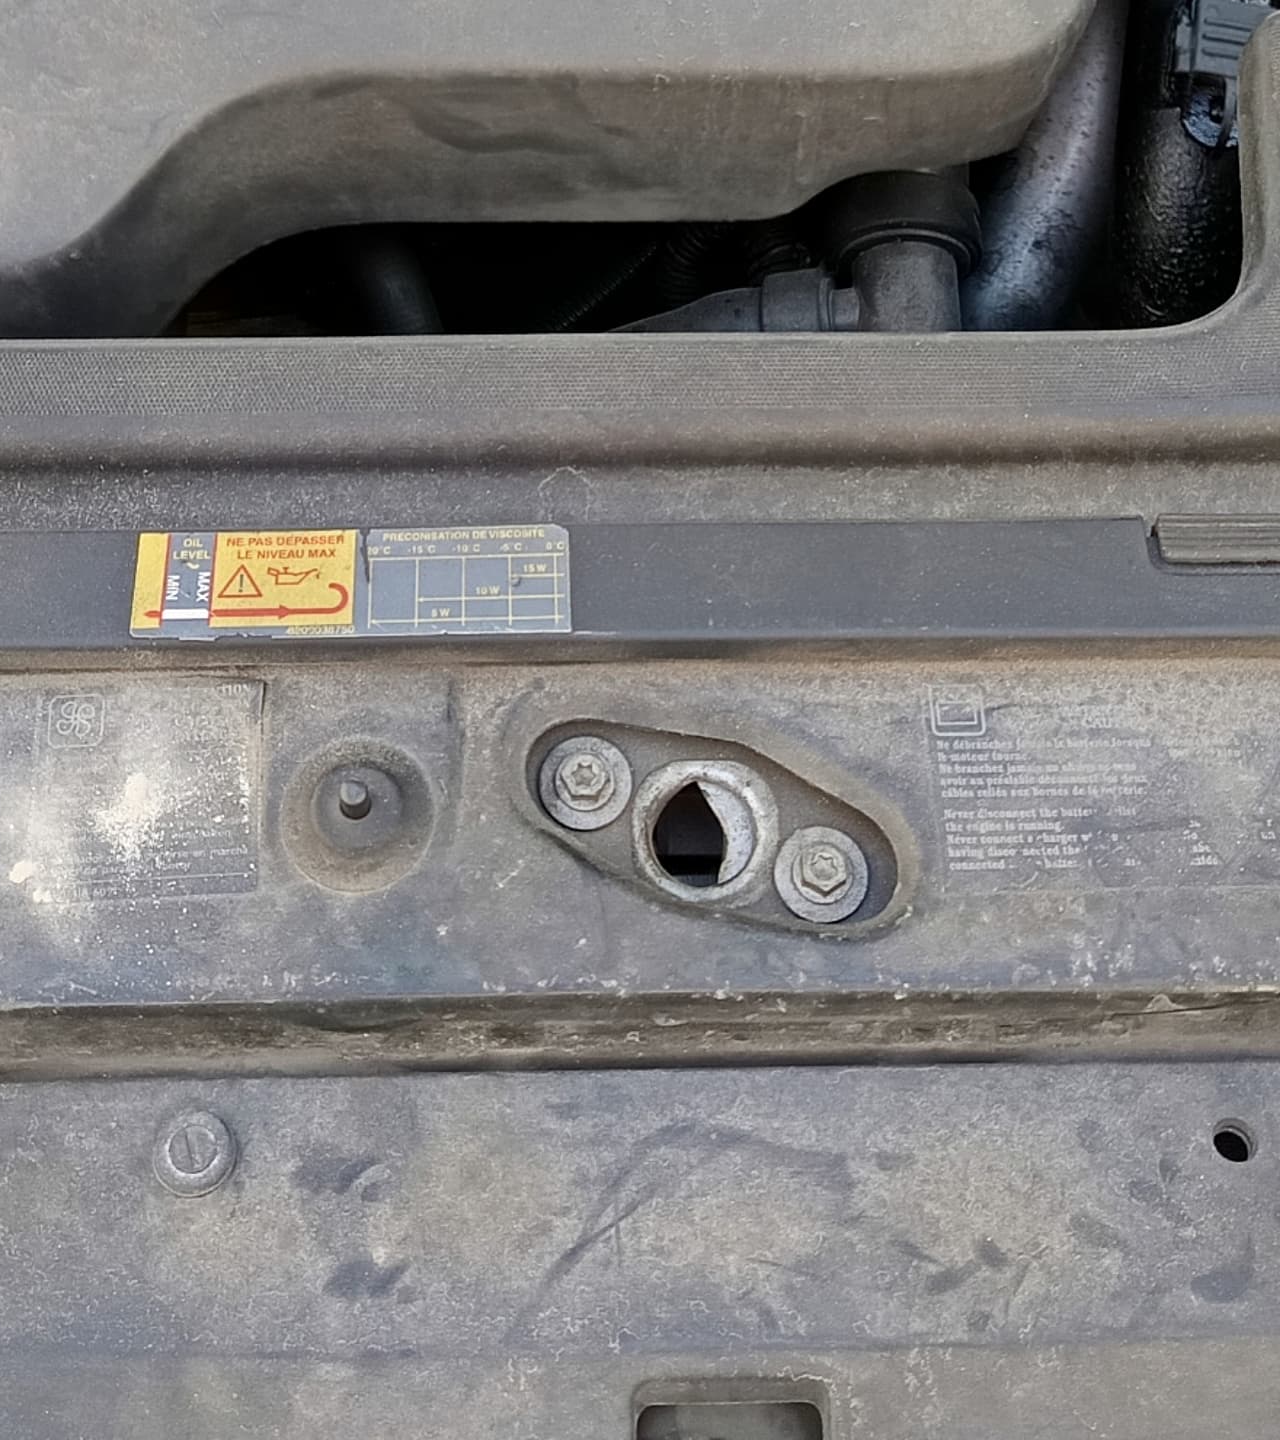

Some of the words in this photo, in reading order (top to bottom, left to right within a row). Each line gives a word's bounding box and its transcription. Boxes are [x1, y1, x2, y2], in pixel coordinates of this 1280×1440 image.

[226, 536, 245, 547] NE
[247, 535, 273, 546] PAS
[471, 530, 486, 540] DE
[182, 537, 204, 547] OIL
[173, 549, 211, 560] LEVEL
[236, 550, 254, 560] LE
[256, 549, 305, 560] NIVEAU
[307, 548, 337, 559] MAX
[165, 574, 181, 601] MIN
[195, 571, 211, 602] MAX
